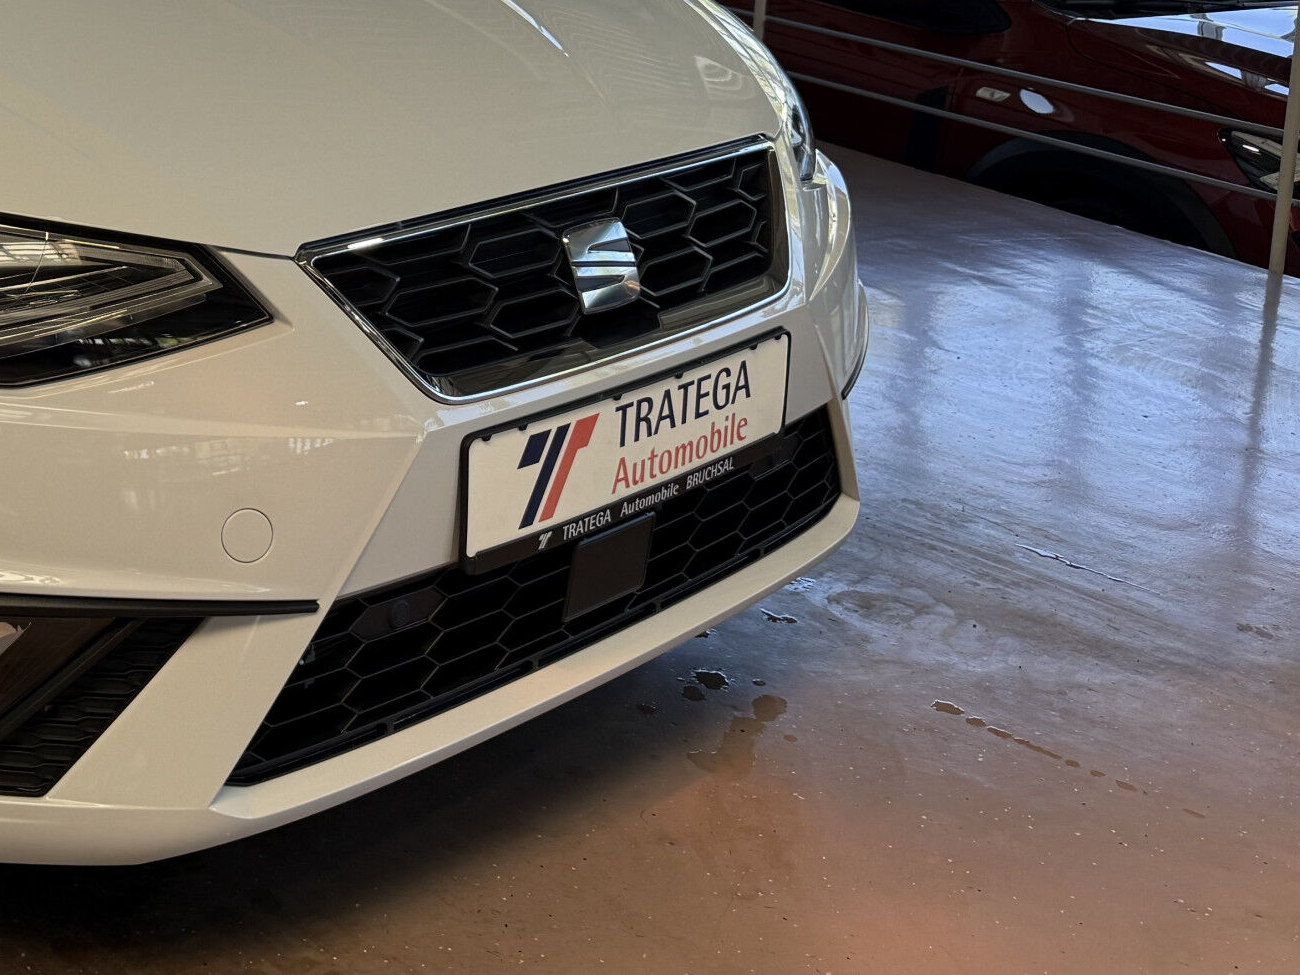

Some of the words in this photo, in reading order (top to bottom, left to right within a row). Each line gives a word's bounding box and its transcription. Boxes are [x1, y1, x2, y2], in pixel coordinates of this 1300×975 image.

[615, 360, 751, 448] TRATEGA
[612, 415, 748, 494] Automobile
[562, 508, 612, 541] TRATEGA
[620, 483, 680, 518] Automobile
[685, 456, 735, 490] BRUCHSAL
